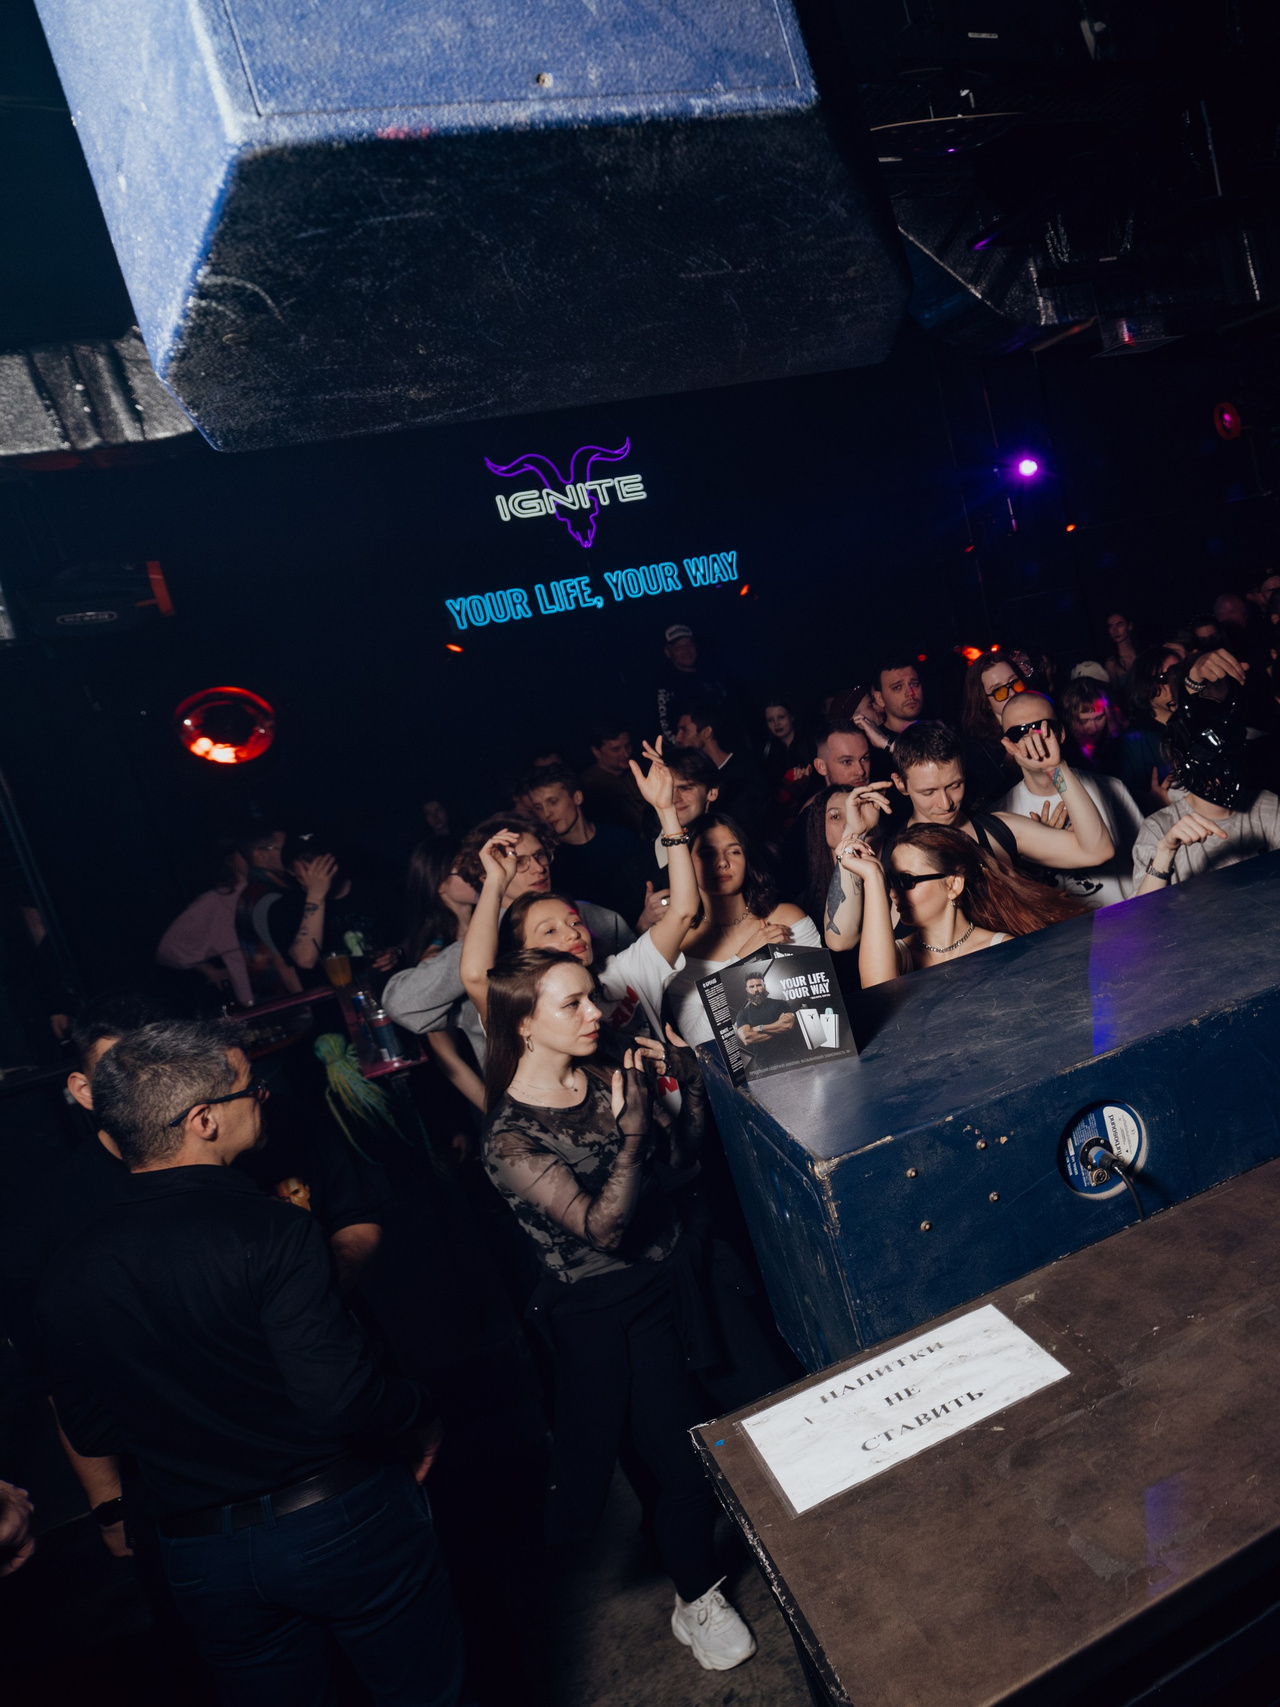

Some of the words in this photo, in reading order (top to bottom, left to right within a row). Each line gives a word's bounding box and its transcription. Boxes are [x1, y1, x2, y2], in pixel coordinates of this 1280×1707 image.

[496, 474, 648, 521] IGNITE
[445, 588, 533, 630] YOUR
[535, 575, 604, 614] LIFE,
[604, 562, 682, 601] YOUR
[683, 551, 738, 589] WAY
[779, 975, 807, 990] YOUR
[782, 986, 810, 1001] YOUR
[810, 982, 830, 996] WAY
[819, 1341, 944, 1404] НАПИТКИ
[884, 1384, 921, 1407] НЕ
[860, 1390, 984, 1452] СТАВИТЬ
